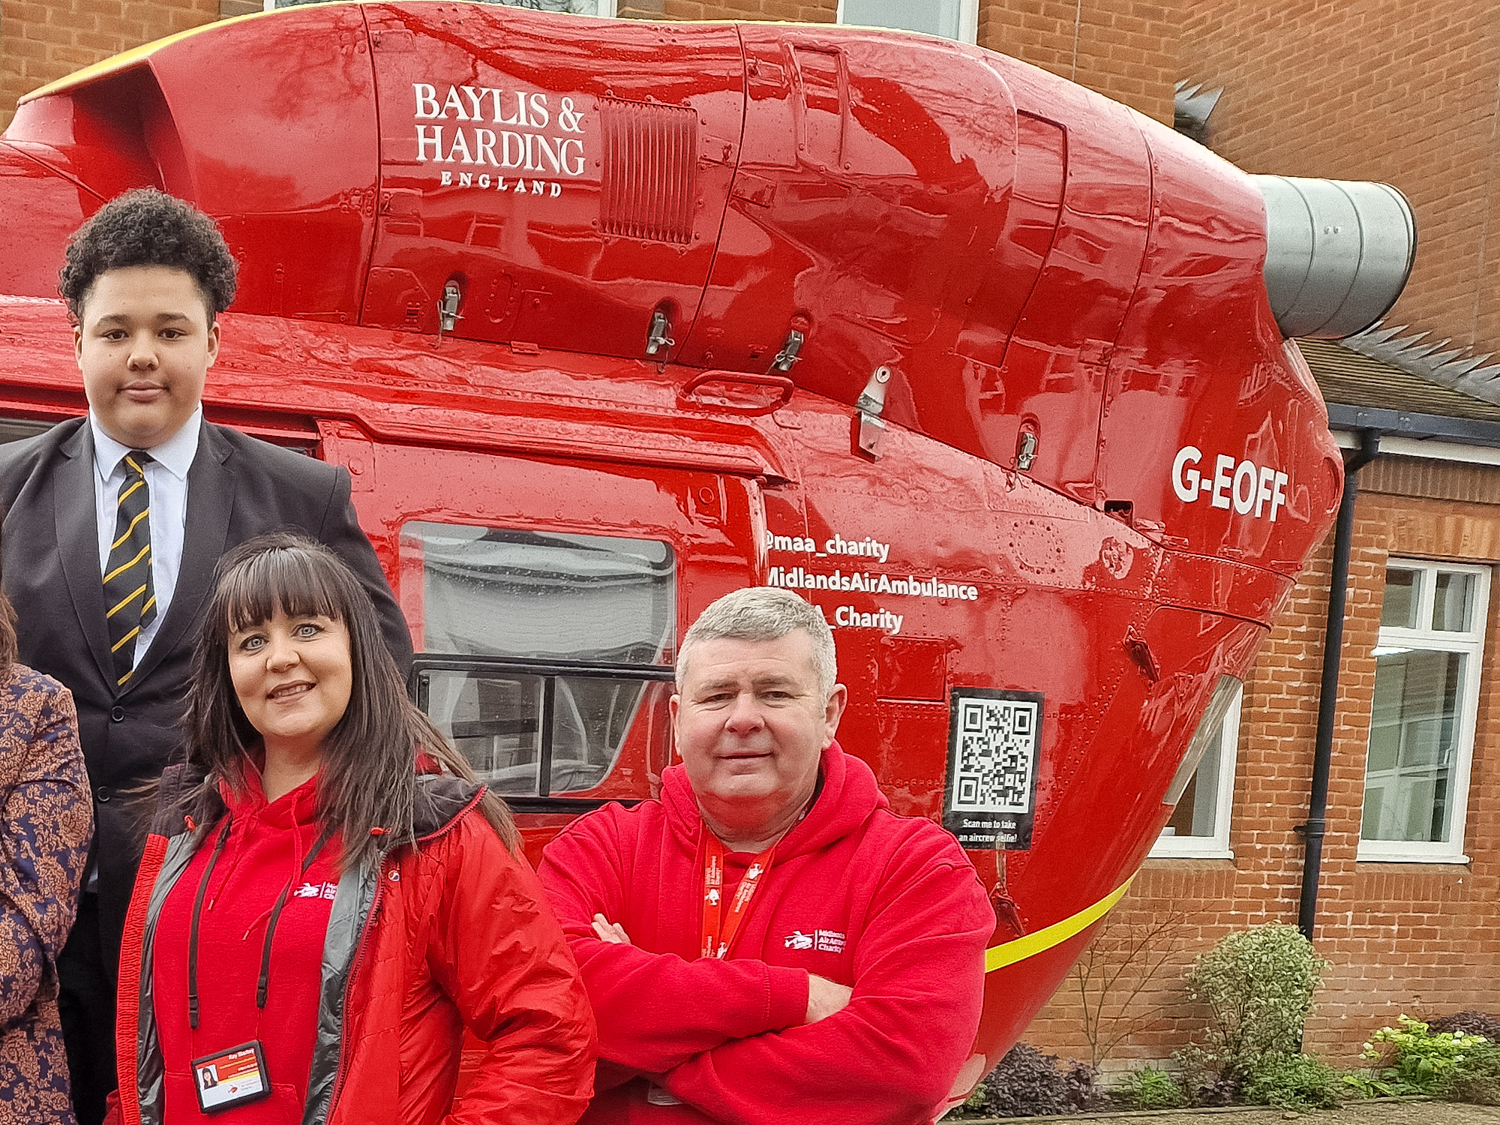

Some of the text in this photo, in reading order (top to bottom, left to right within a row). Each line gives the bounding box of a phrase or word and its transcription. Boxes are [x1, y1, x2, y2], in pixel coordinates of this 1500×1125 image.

[412, 83, 586, 133] BAYLIS &
[415, 125, 586, 176] HARDING
[440, 171, 562, 197] ENGLAND
[1172, 445, 1288, 522] G-EOFF
[958, 834, 968, 842] an
[963, 818, 980, 828] Scan
[993, 819, 1000, 829] to
[1001, 819, 1017, 829] take
